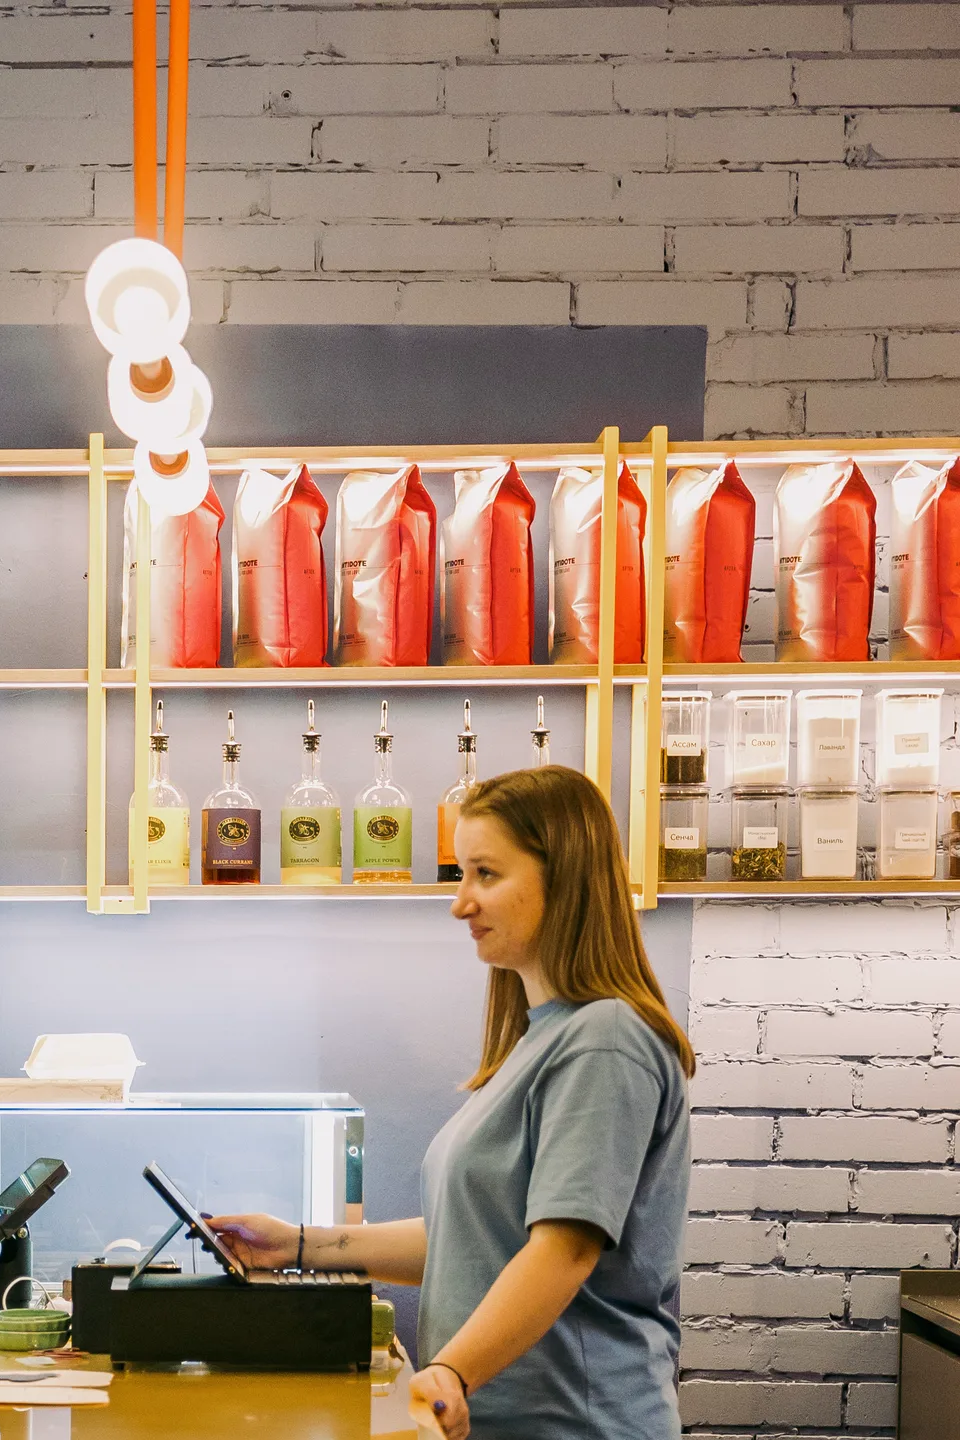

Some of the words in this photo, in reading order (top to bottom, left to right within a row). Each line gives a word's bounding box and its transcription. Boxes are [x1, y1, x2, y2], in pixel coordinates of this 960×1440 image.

[671, 740, 697, 748] Ассам
[751, 738, 776, 748] Сахар
[670, 833, 694, 841] Сенча
[817, 837, 844, 845] Ваниль
